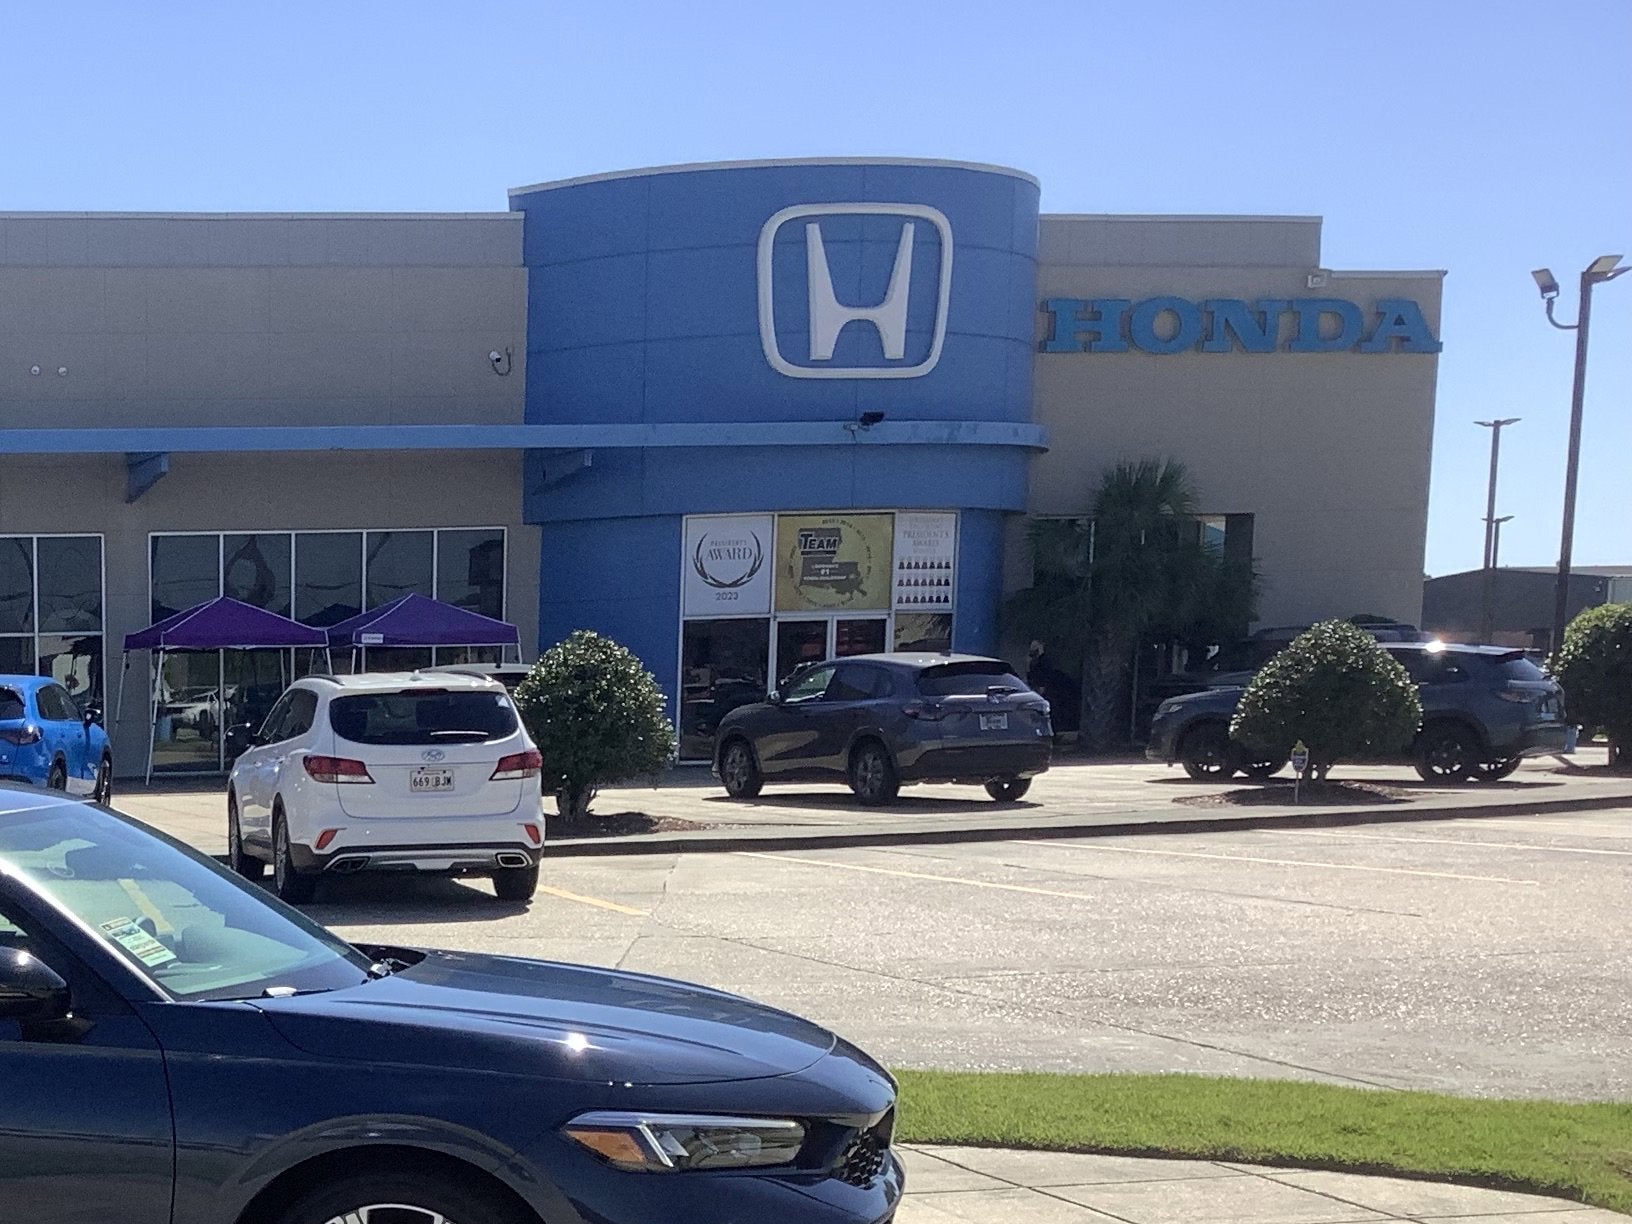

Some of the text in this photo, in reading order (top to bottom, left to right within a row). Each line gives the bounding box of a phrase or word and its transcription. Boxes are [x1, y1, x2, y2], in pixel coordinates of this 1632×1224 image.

[1040, 295, 1444, 354] HONDA
[800, 532, 838, 550] TEAM
[706, 547, 753, 561] AWARD
[715, 592, 739, 601] 2023
[413, 777, 430, 787] 669
